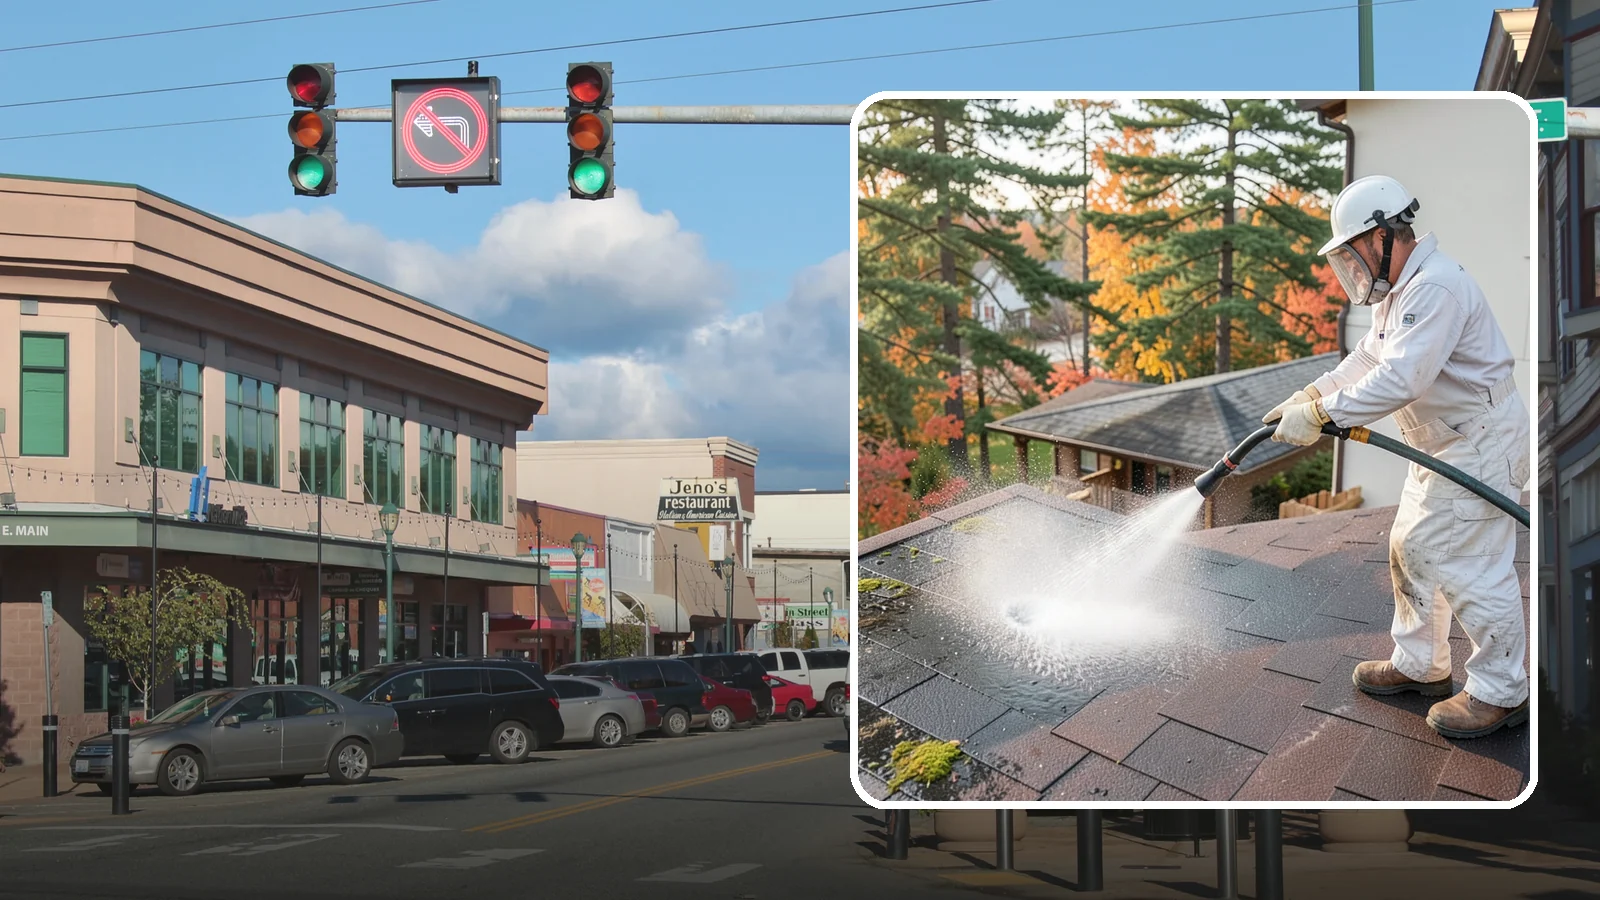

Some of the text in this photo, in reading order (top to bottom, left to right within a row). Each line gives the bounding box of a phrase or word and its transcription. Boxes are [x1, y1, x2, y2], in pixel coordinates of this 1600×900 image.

[670, 480, 727, 494] Jeno's
[665, 496, 731, 509] restaurant
[2, 525, 49, 536] E. MAIN
[797, 607, 828, 617] Street
